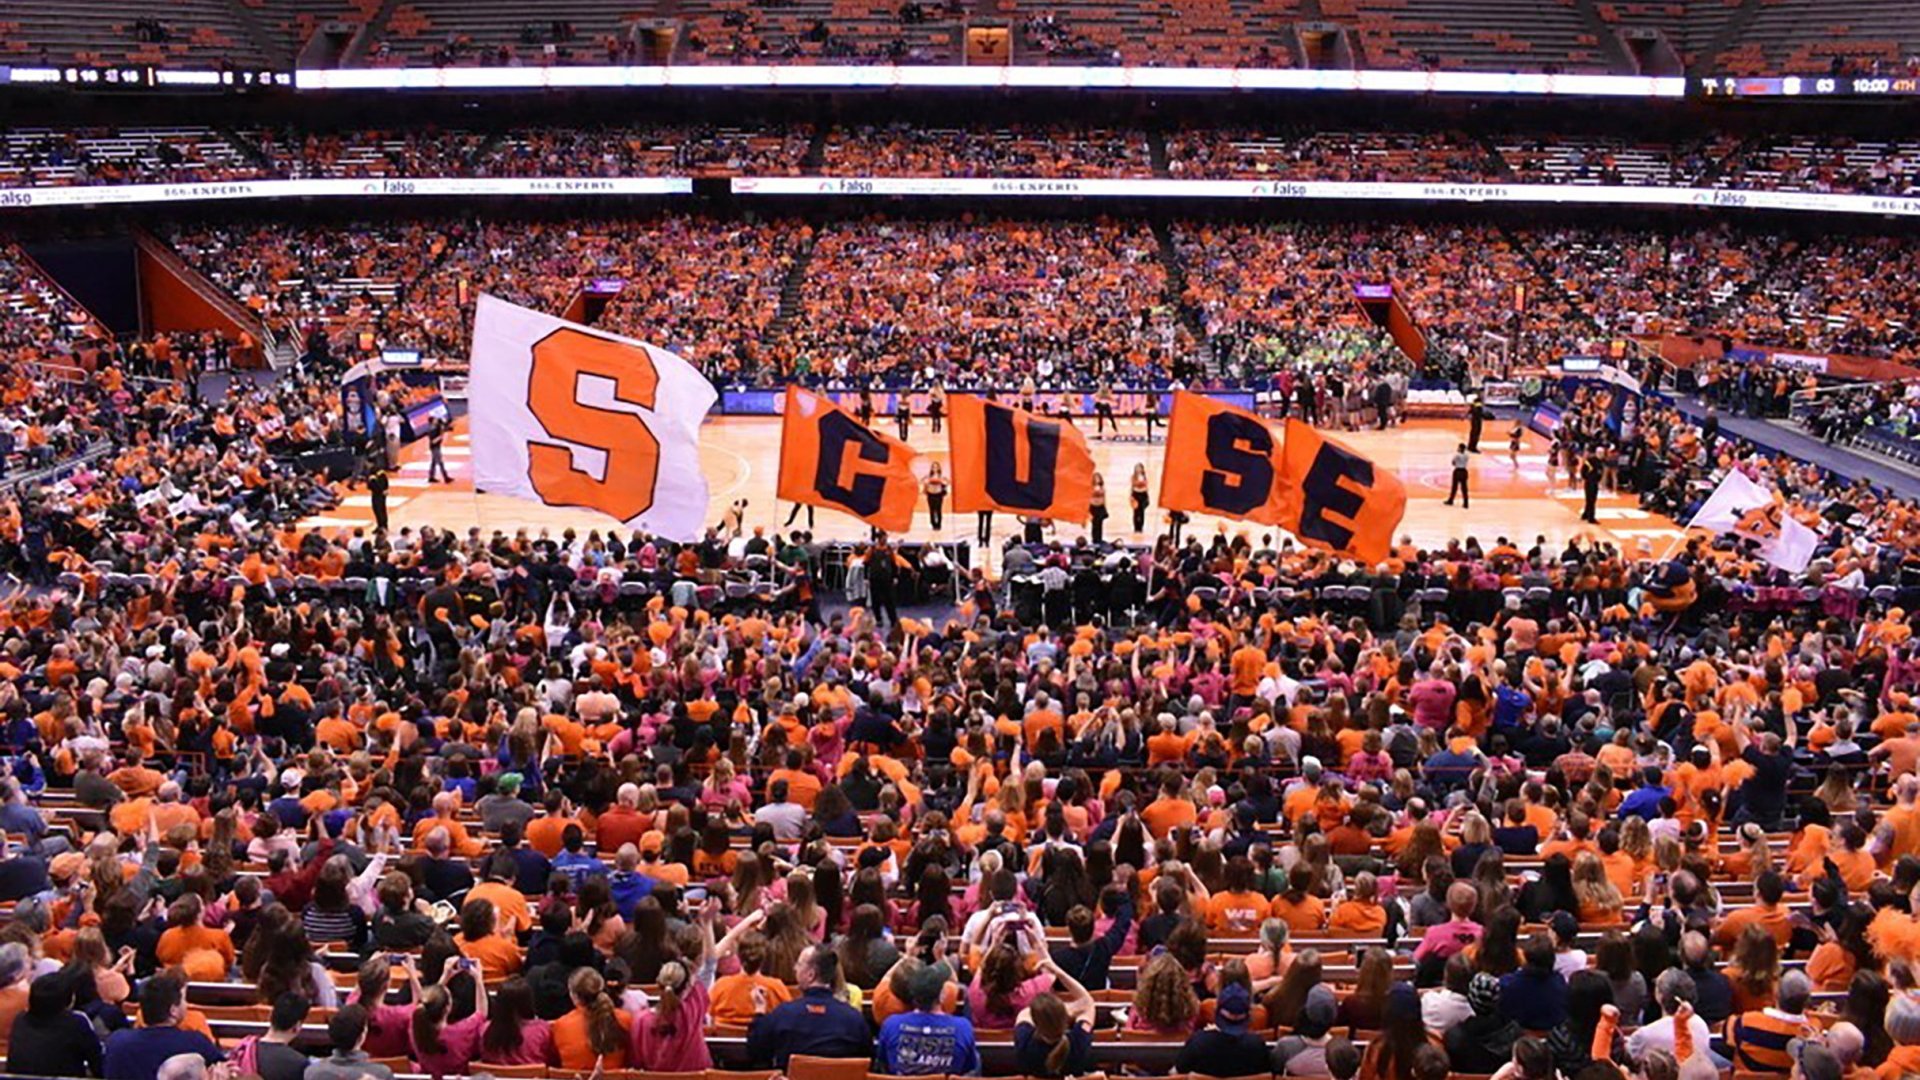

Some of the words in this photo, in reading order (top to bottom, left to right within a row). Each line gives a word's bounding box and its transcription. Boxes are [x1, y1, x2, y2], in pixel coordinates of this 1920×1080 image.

[1853, 79, 1889, 92] 10:00
[1892, 79, 1916, 90] 4TH
[383, 180, 415, 194] Falso
[839, 179, 873, 193] Falso
[1273, 182, 1307, 196] Falso
[1713, 191, 1747, 206] Falso
[527, 326, 660, 524] S
[814, 409, 890, 518] C
[985, 402, 1061, 511] U
[1200, 410, 1275, 515] S
[1300, 440, 1374, 551] E
